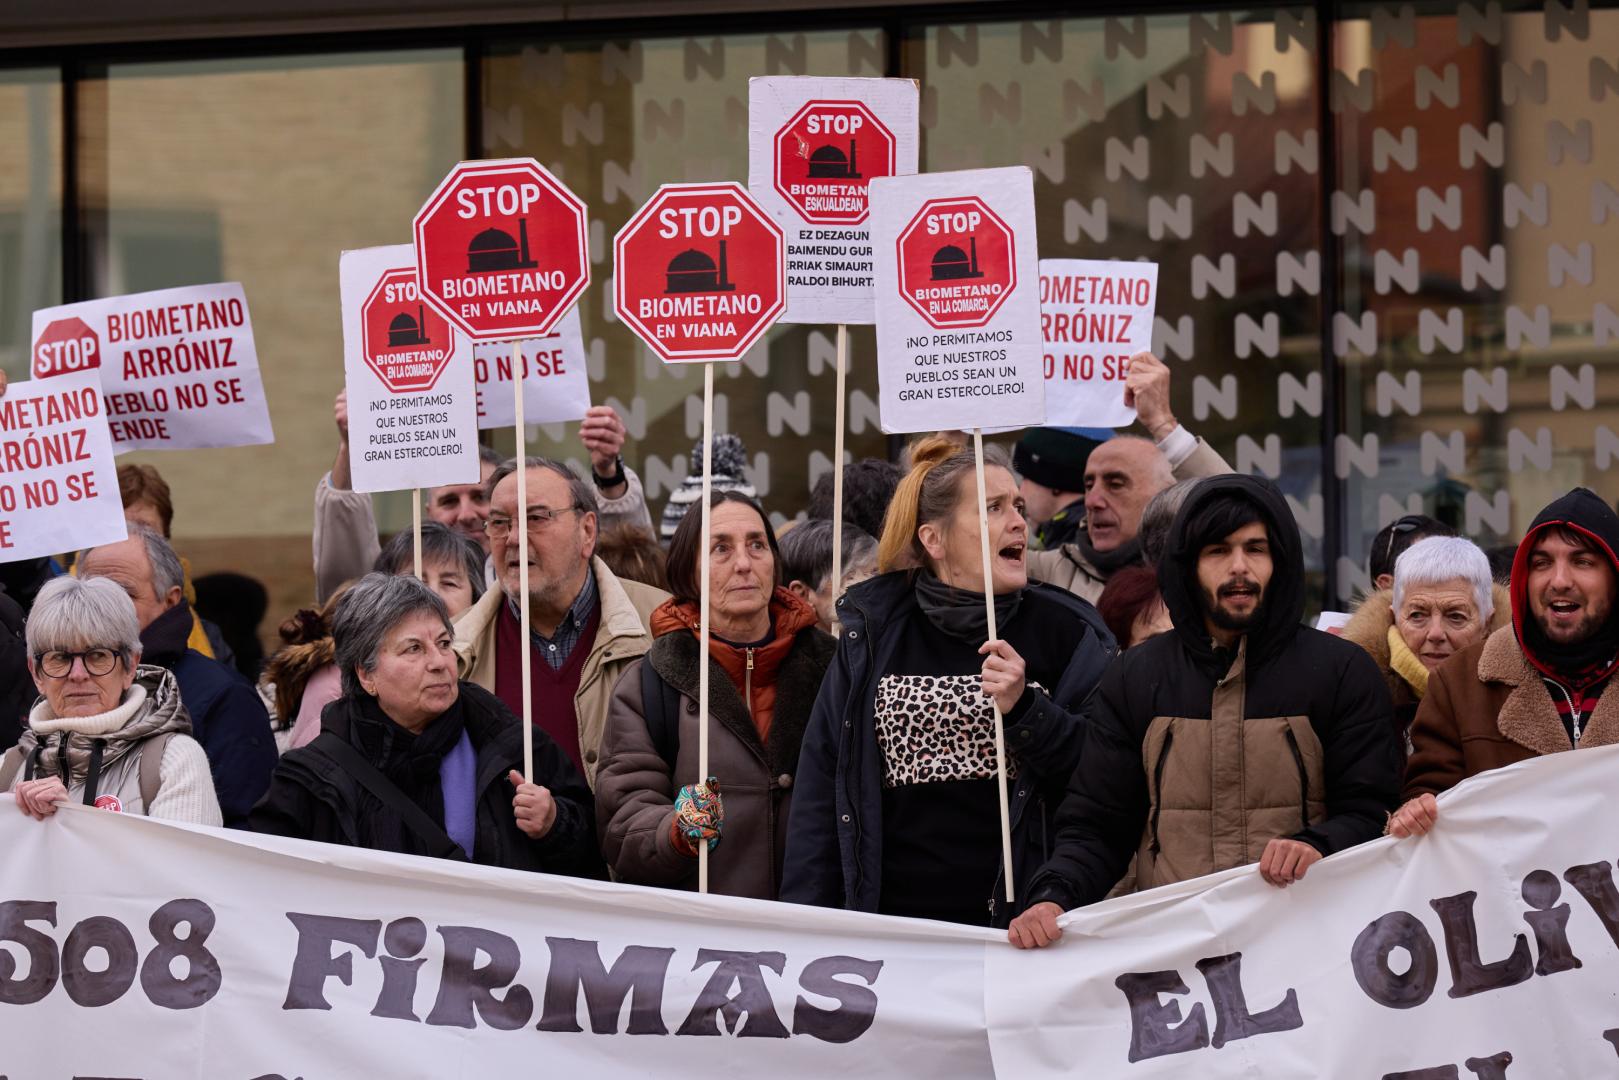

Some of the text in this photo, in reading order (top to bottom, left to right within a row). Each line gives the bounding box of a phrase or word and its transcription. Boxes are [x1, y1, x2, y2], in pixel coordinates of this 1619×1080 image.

[807, 114, 863, 135] STOP
[790, 184, 868, 196] BIOMETAN
[457, 183, 540, 219] STOP
[805, 197, 863, 212] ESKUALDEAN
[659, 205, 742, 239] STOP
[926, 211, 981, 235] STOP
[799, 230, 869, 241] EZ DEZAGUN
[788, 245, 873, 257] BAIMENDU GUR
[787, 260, 873, 271] RRIAK SIMAURT
[442, 270, 566, 299] BIOMETANO
[787, 276, 874, 287] RALDOI BIHURT
[1040, 276, 1151, 306] OMETANO
[385, 282, 423, 303] STO
[915, 283, 1002, 300] BIOMETANO
[461, 299, 543, 318] EN VIANA
[639, 294, 762, 318] BIOMETANO
[929, 298, 990, 315] EN LA COMARCA
[107, 298, 244, 343] BIOMETANO
[656, 322, 737, 338] EN VIANA
[1041, 308, 1133, 343] RRÓNIZ
[933, 330, 1013, 346] PERMITAMOS
[36, 337, 97, 373] STOP
[122, 337, 237, 381] ARRÓNIZ
[376, 349, 444, 366] BIOMETANO
[536, 350, 565, 377] SE
[914, 349, 1007, 366] QUE NUESTROS
[387, 363, 434, 379] EN LA COMARCA
[905, 366, 1017, 384] PUEBLOS SEAN UN
[1063, 354, 1094, 380] NO
[1102, 355, 1130, 380] SE
[174, 383, 208, 410] NO
[215, 378, 244, 405] SE
[898, 382, 1025, 401] GRAN ESTERCOLERO!
[0, 387, 99, 431] METANO
[390, 394, 453, 409] PERMITAMOS
[376, 412, 448, 428] QUE NUESTROS
[108, 418, 171, 442] ENDE
[369, 428, 456, 445] PUEBLOS SEAN UN
[365, 443, 463, 461] GRAN ESTERCOLERO!
[23, 479, 59, 509] NO
[66, 471, 98, 502] SE
[1115, 951, 1304, 1063] EL
